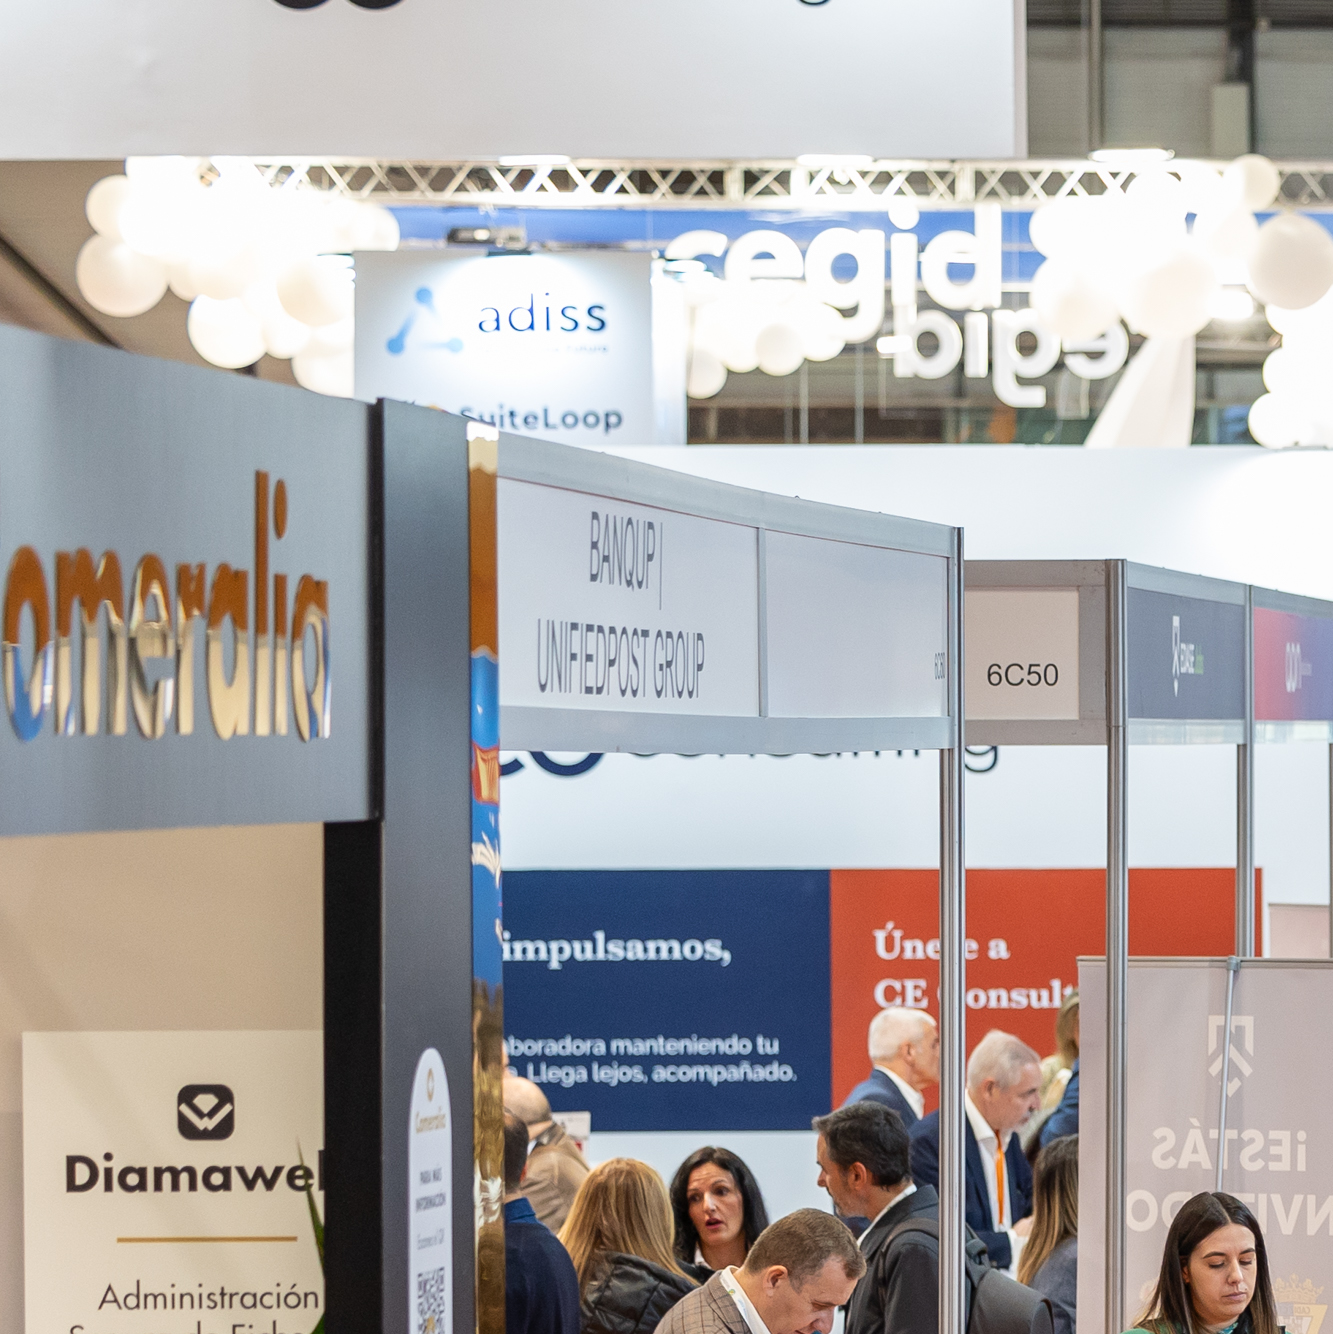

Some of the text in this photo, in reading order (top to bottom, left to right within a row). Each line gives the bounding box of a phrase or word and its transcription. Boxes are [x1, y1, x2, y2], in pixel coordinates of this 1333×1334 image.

[478, 292, 608, 333] adiss
[590, 511, 656, 591] BANQUP
[537, 618, 705, 699] UNIFIEDPOST GROUP
[987, 663, 1059, 687] 6C50
[502, 930, 732, 970] impulsamos,
[872, 921, 1011, 961] Únee a
[874, 978, 1074, 1010] CE onsul
[610, 1033, 753, 1056] manteniendo
[756, 1033, 780, 1055] tu
[526, 1061, 588, 1088] Llega
[591, 1060, 648, 1087] lejos,
[651, 1059, 798, 1087] acompañado.
[98, 1279, 319, 1311] Administración
